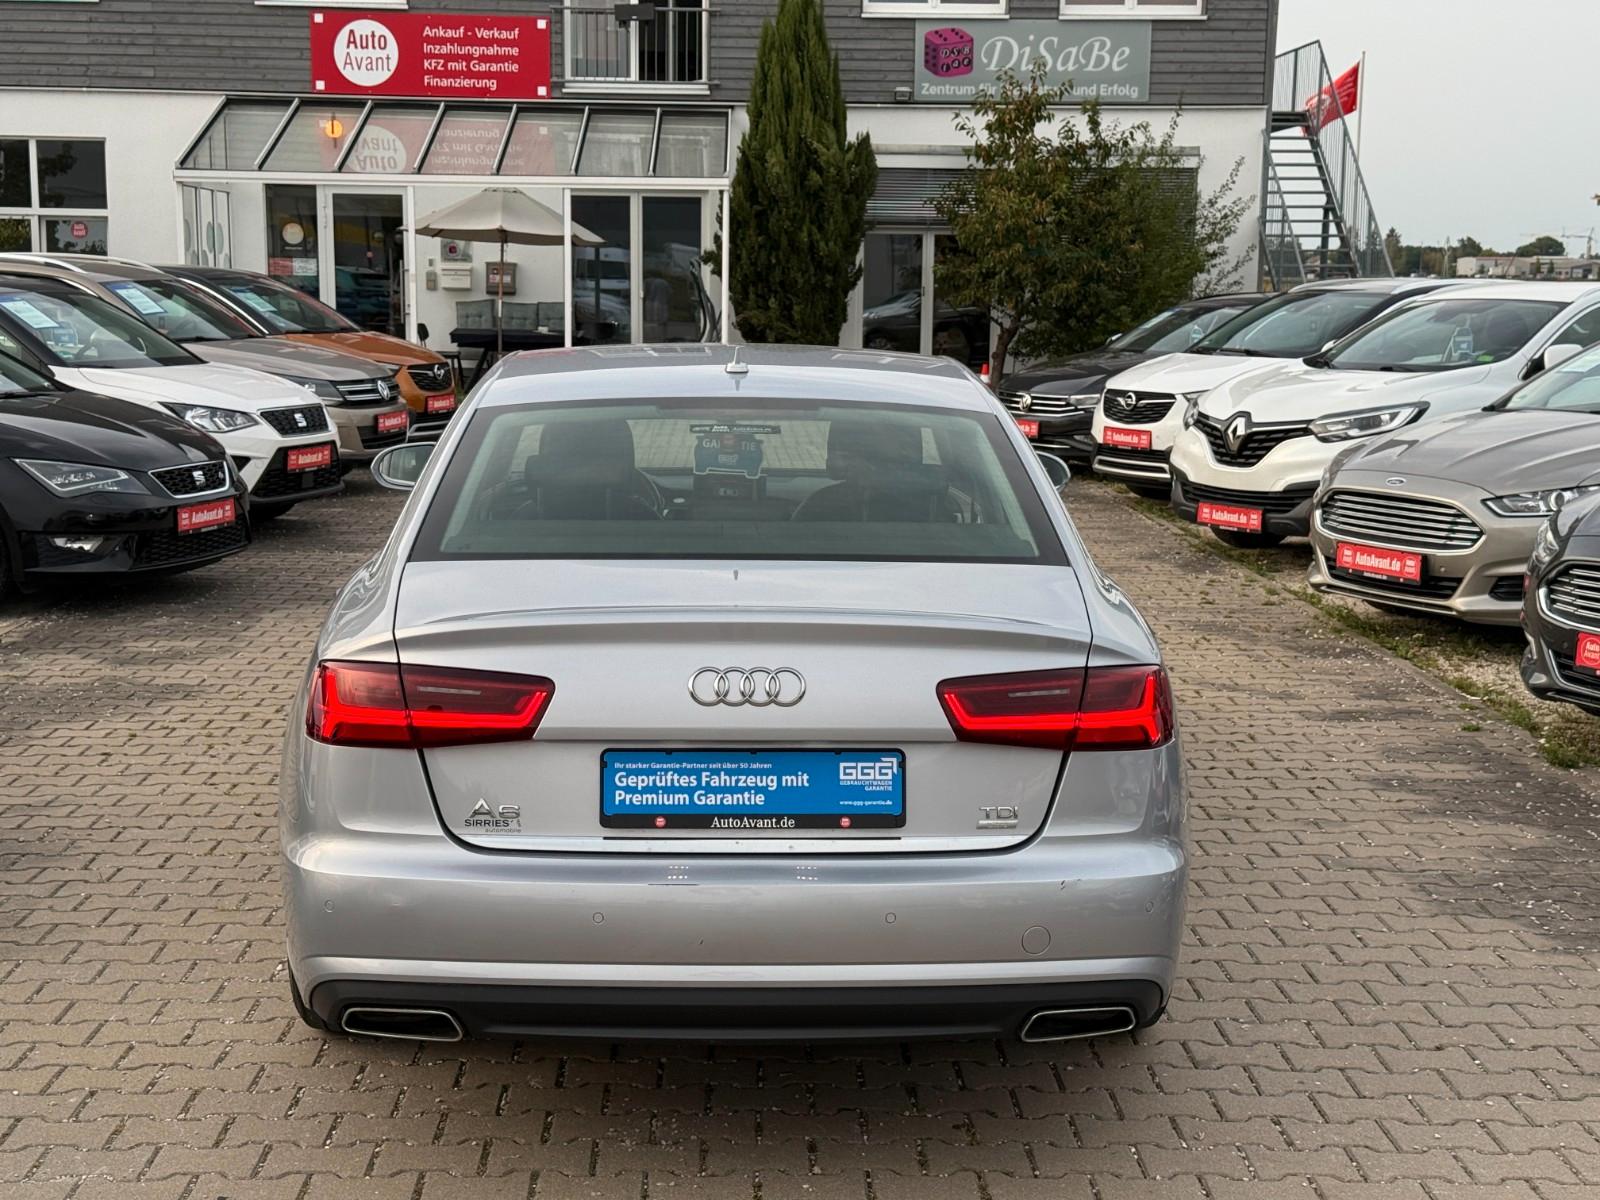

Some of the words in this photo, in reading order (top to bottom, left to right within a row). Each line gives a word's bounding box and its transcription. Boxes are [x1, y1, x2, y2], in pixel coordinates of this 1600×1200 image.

[346, 29, 388, 50] Auto
[423, 25, 465, 38] Ankauf
[475, 27, 519, 39] Verkauf
[423, 42, 519, 58] Inzahlungnahme
[981, 34, 1130, 73] DiSaBe
[343, 51, 391, 72] Avant
[423, 59, 444, 71] KFZ
[447, 60, 467, 71] mit
[470, 60, 519, 72] Garantie
[423, 75, 497, 91] Finanzierung
[921, 83, 976, 96] Zentrum
[1073, 84, 1096, 96] und
[1100, 83, 1138, 98] Erfolg
[1355, 551, 1401, 572] AutoAvant.de
[839, 762, 893, 780] GGG
[614, 771, 698, 791] Geprüftes
[701, 771, 778, 791] Fahrzeug
[782, 771, 810, 787] mit
[614, 790, 690, 806] Premium
[693, 790, 765, 806] Garantie
[468, 798, 521, 819] A6
[979, 806, 1018, 820] TDI
[711, 816, 796, 829] AutoAvant.de
